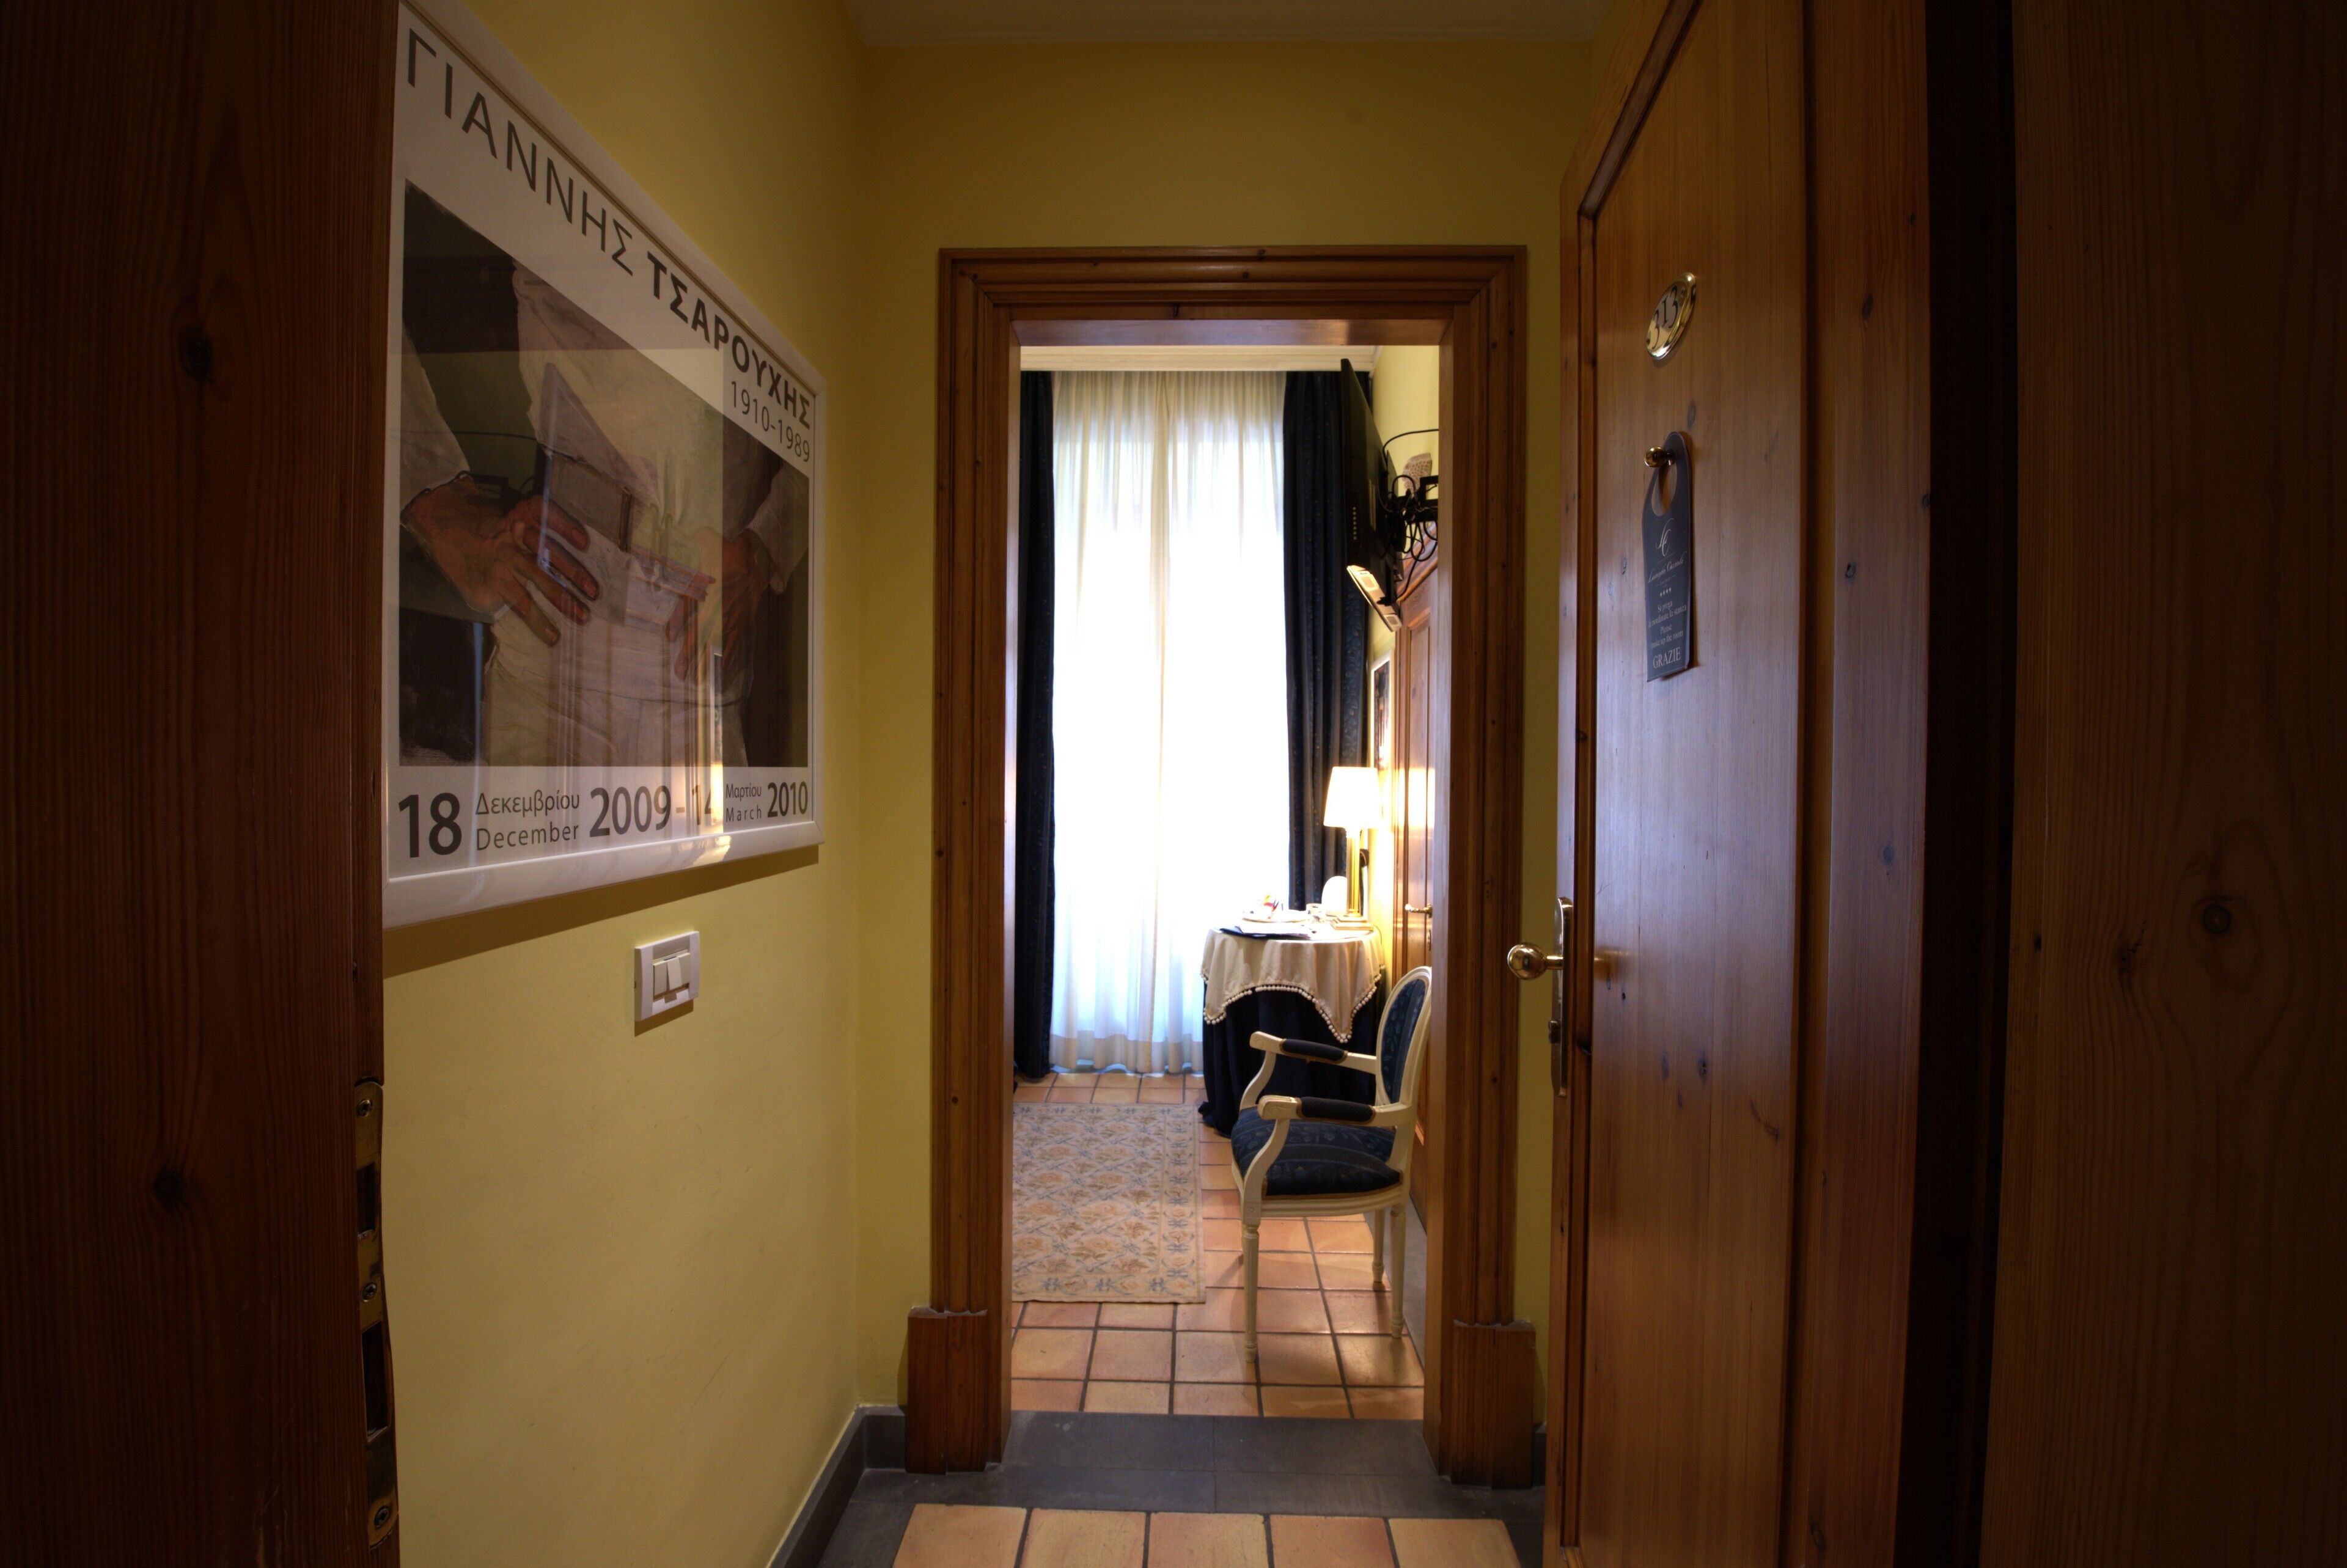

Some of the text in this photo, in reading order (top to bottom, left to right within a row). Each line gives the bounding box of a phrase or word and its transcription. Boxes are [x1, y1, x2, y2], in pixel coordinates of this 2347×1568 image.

[407, 27, 810, 430] ΓΙΑΝΝΗΣ ΤΣΑΡΟΥΧΗΣ
[731, 381, 810, 462] 1910-1989
[1660, 624, 1672, 635] Please
[1672, 629, 1684, 640] room
[1653, 647, 1681, 669] GRAZIE
[398, 792, 462, 858] 18
[475, 789, 579, 818] Δεκεμβρίου
[725, 782, 762, 801] Μαρτίου
[767, 781, 808, 818] 2010
[725, 804, 762, 822] March
[476, 821, 579, 851] December
